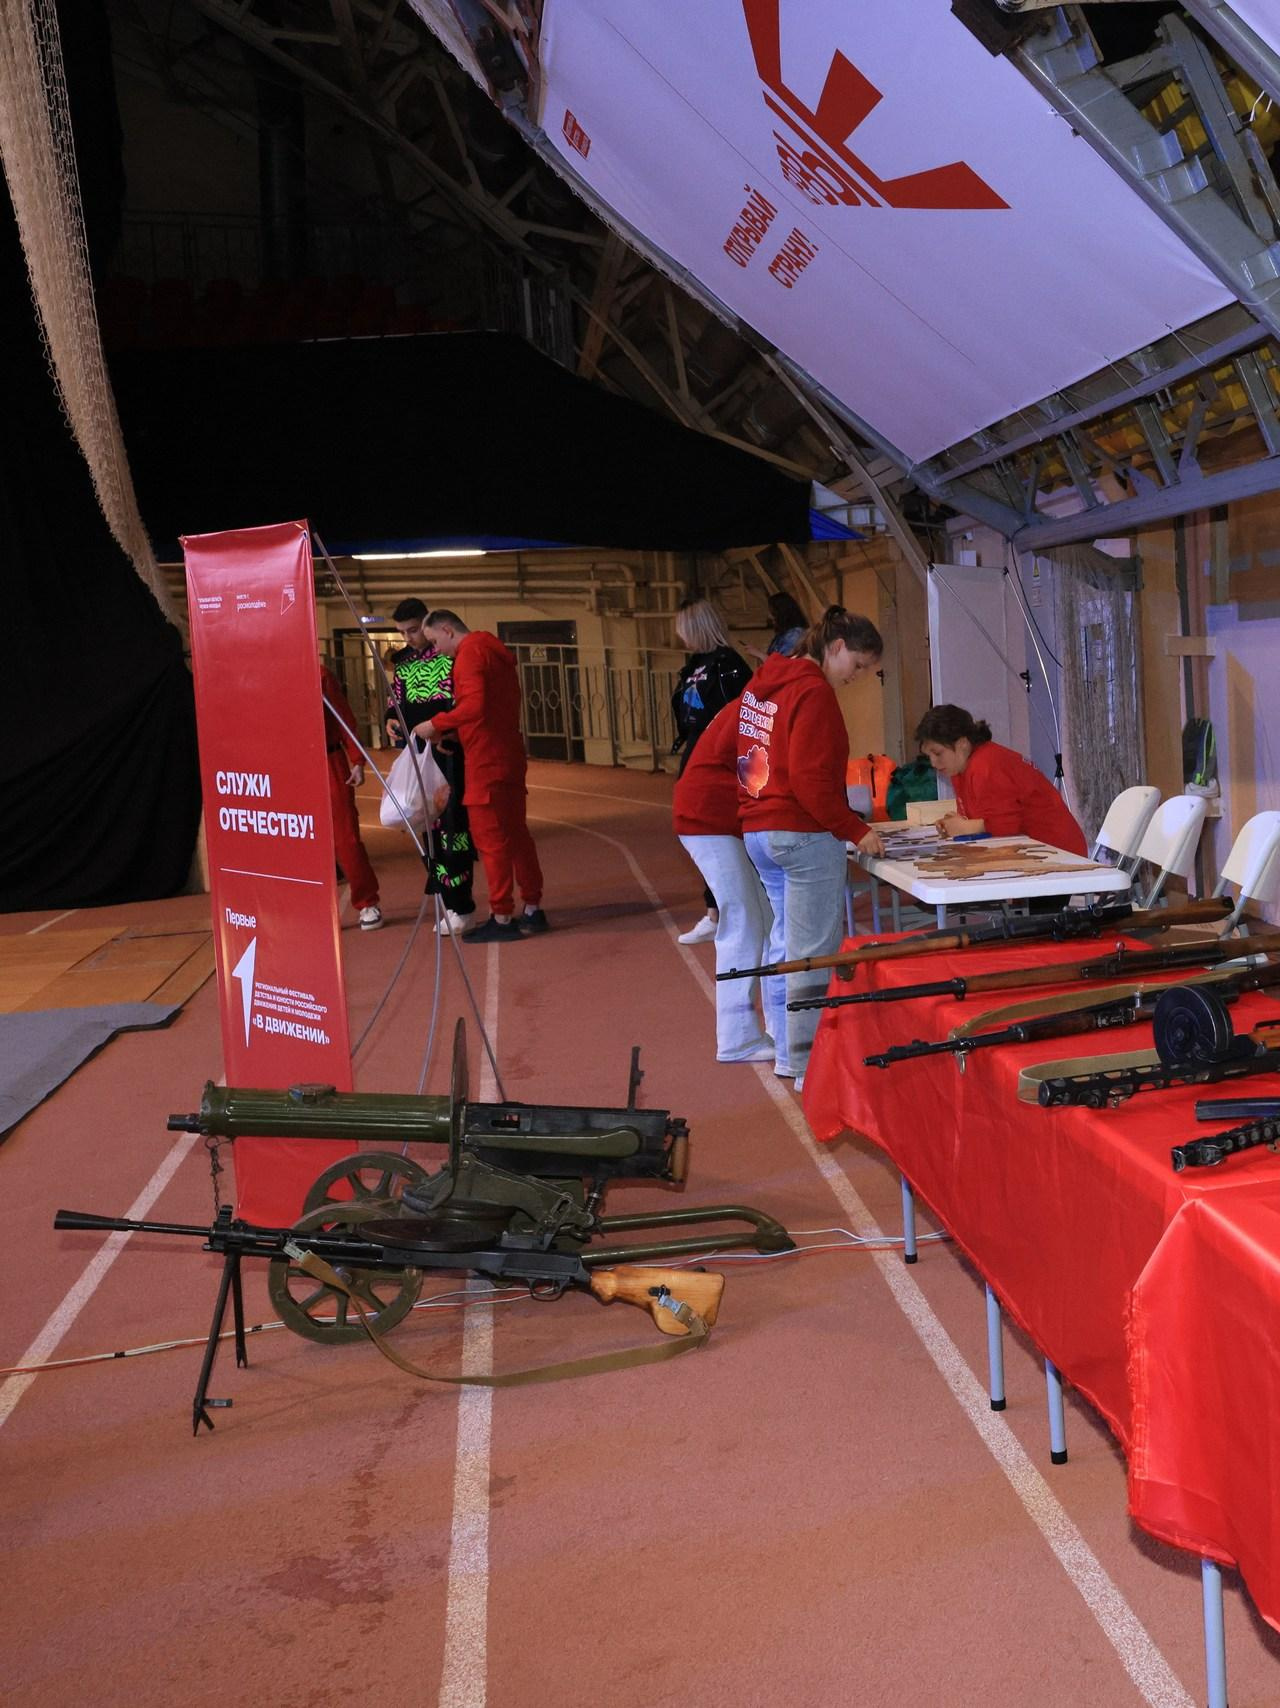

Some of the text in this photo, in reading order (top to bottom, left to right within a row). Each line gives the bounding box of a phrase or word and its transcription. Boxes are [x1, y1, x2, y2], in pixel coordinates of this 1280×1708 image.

[723, 184, 778, 268] ОТКРЫВАЙ
[768, 227, 819, 289] СТРАНУ!
[216, 771, 271, 798] СЛУЖИ
[219, 807, 314, 840] ОТЕЧЕСТВУ!
[226, 908, 256, 930] Первые
[289, 989, 315, 1002] ФЕСТИВАЛЬ
[252, 1013, 330, 1045] «В ДВИЖЕНИИ»
